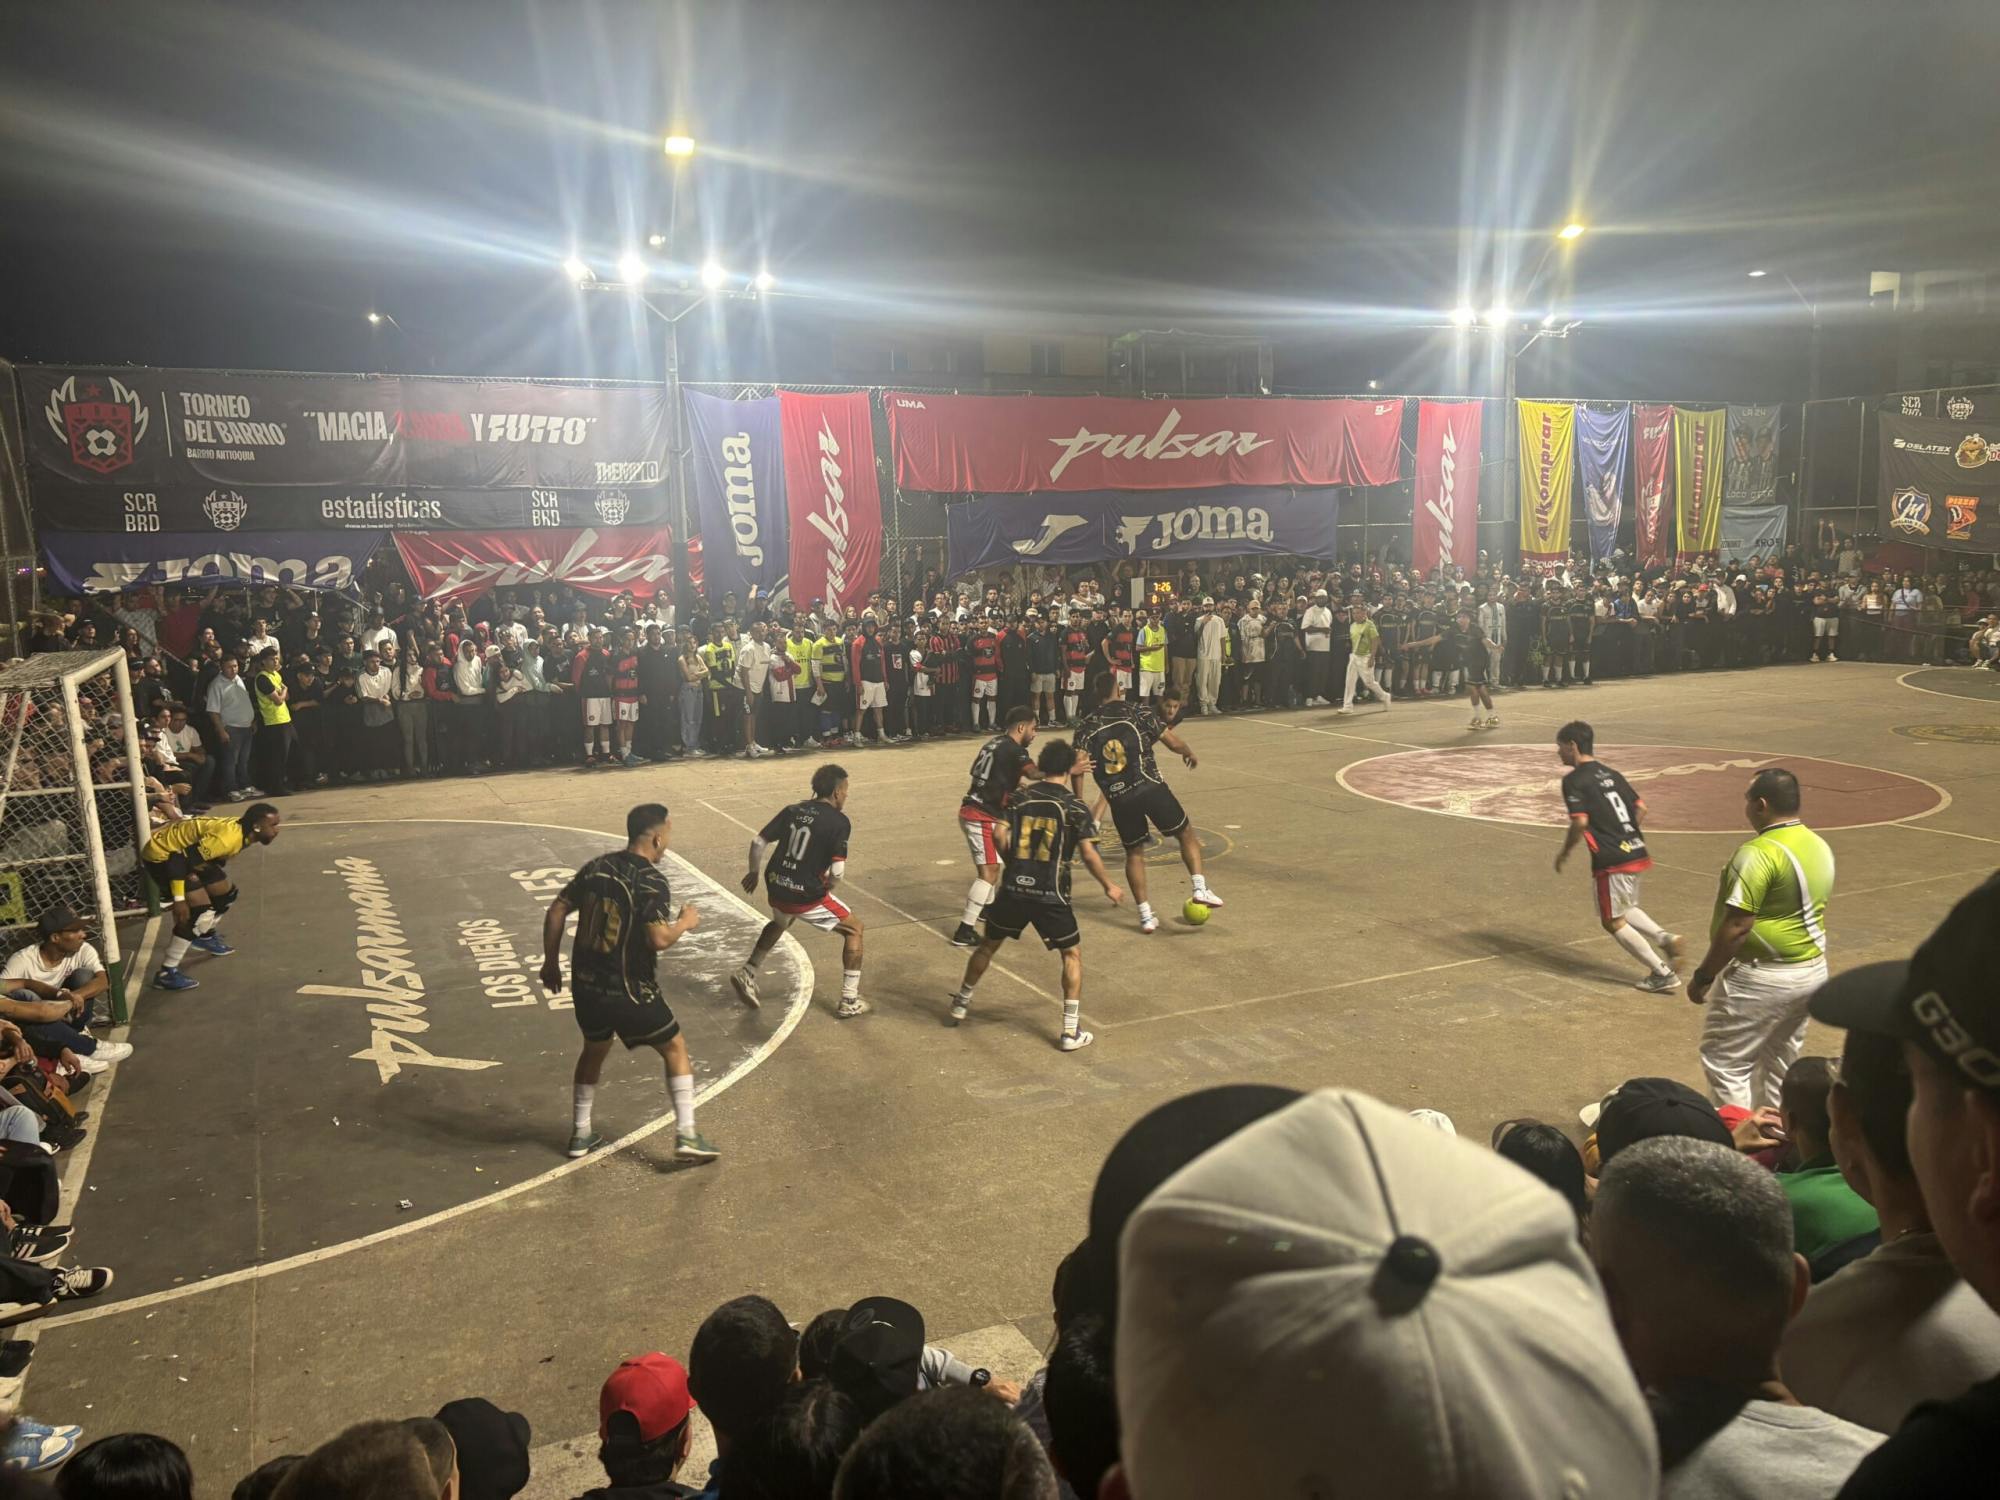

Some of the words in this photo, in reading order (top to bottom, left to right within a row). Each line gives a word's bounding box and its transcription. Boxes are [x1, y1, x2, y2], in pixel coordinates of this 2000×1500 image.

[180, 392, 250, 418] TORNEO
[184, 420, 217, 443] DEL
[214, 421, 286, 446] BARRIO
[470, 413, 483, 441] Y
[187, 447, 214, 459] BARRIO
[216, 449, 255, 461] ANTIOQUIA
[1048, 408, 1274, 483] pulsar
[124, 493, 157, 512] SCR
[322, 492, 441, 519] estadísticas
[532, 490, 558, 508] SCR
[125, 514, 160, 532] BRD
[532, 509, 560, 527] BRD
[1102, 739, 1127, 775] 9
[785, 823, 811, 861] 10
[480, 973, 539, 1008] LOS
